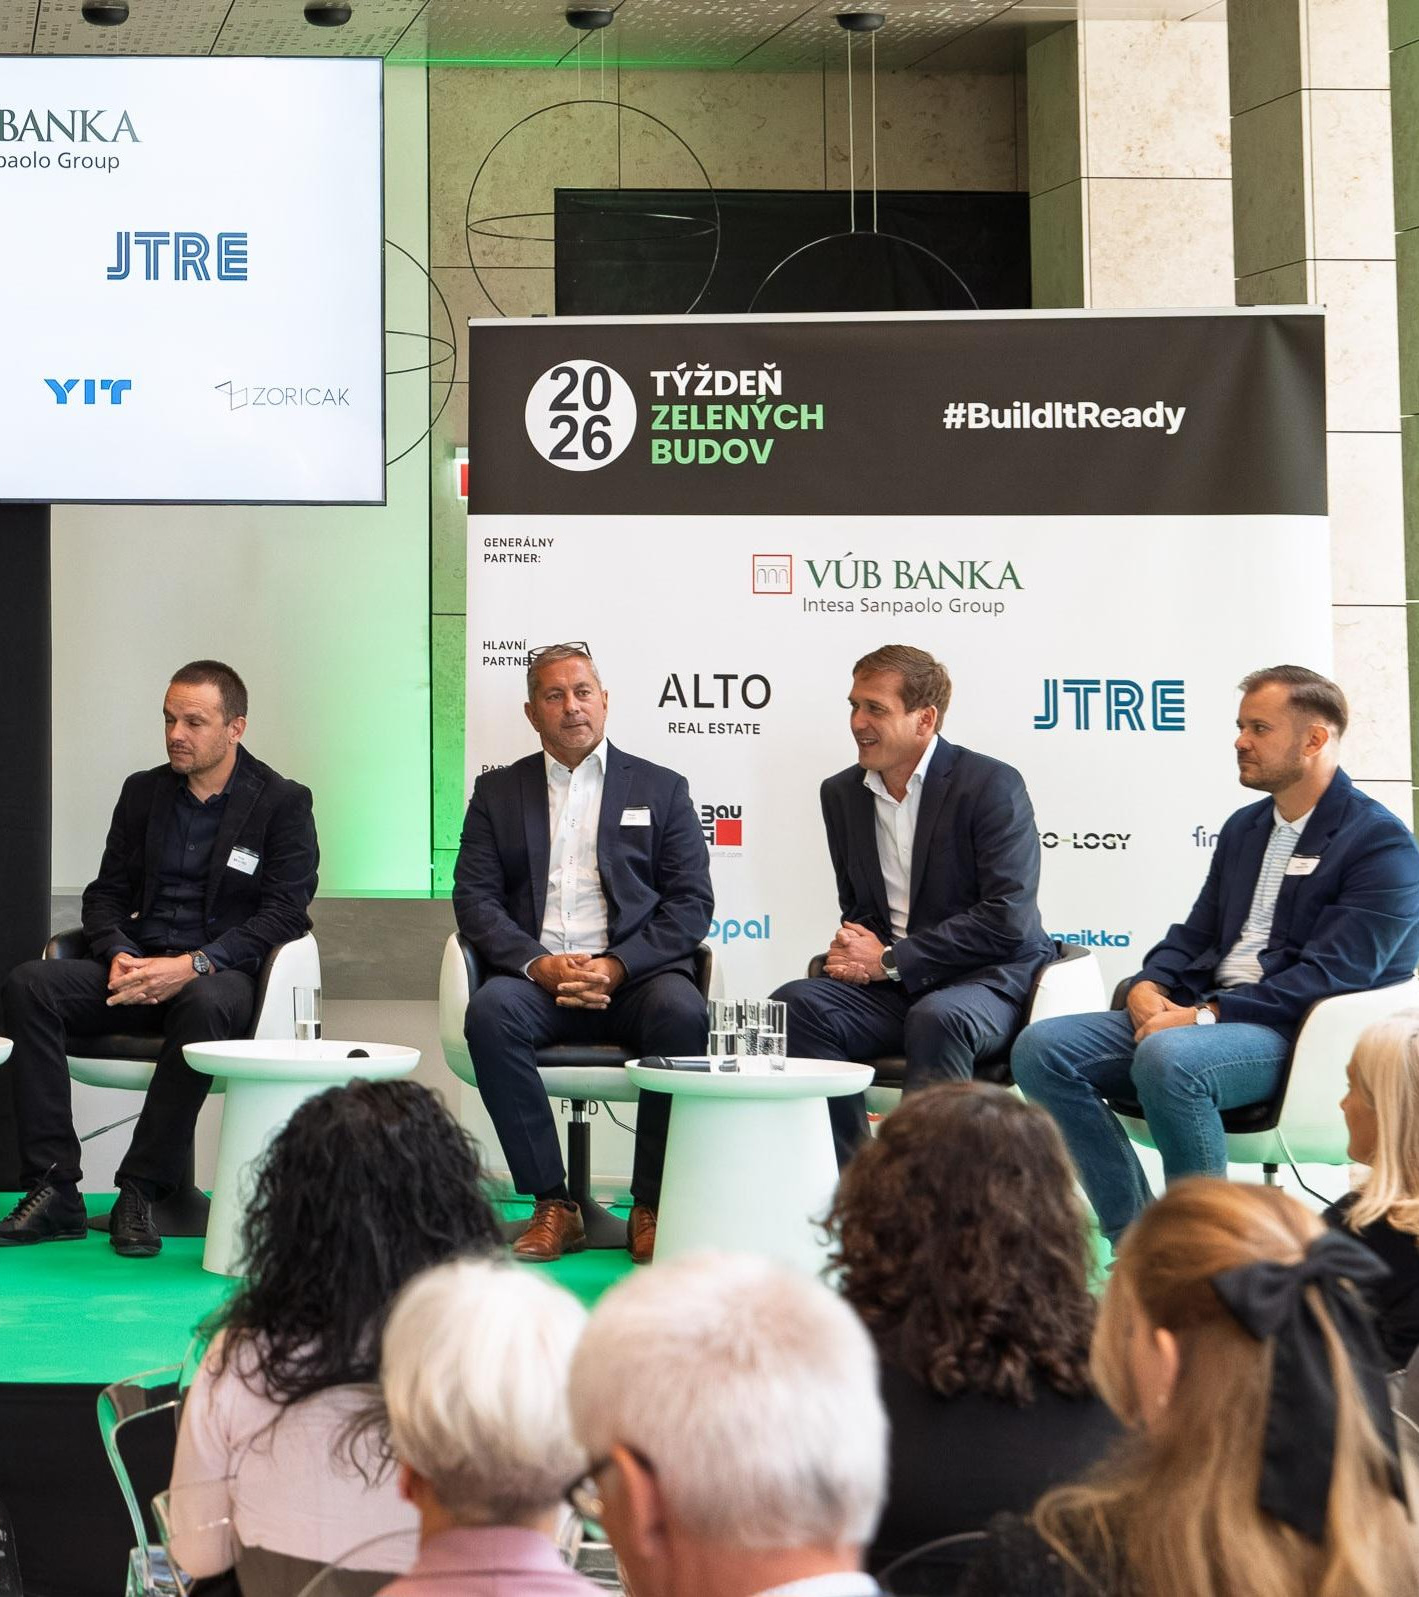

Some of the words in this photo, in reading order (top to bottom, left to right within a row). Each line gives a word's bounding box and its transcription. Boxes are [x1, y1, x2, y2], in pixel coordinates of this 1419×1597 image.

[58, 152, 120, 174] Group
[106, 231, 248, 281] JTRE
[43, 379, 132, 405] YIT
[549, 366, 612, 411] 20
[650, 362, 783, 397] TÝŽDEŇ
[253, 387, 350, 407] ZORICAK
[651, 398, 824, 430] ZELENÝCH
[943, 400, 1187, 435] #BuildItReady
[549, 415, 613, 461] 26
[651, 438, 775, 465] BUDOV
[483, 536, 554, 548] GENERÁLNY
[483, 553, 541, 563] PARTNER:
[804, 552, 882, 590] VÚB
[893, 560, 1025, 590] BANKA
[803, 597, 855, 613] Intesa
[860, 597, 943, 617] Sanpaolo
[949, 597, 1005, 617] Group
[482, 639, 527, 650] HLAVNÍ
[482, 656, 536, 666] PARTNE
[658, 673, 772, 710] ALTO
[1034, 678, 1186, 732] JTRE
[669, 721, 705, 734] REAL
[709, 722, 761, 735] ESTATE
